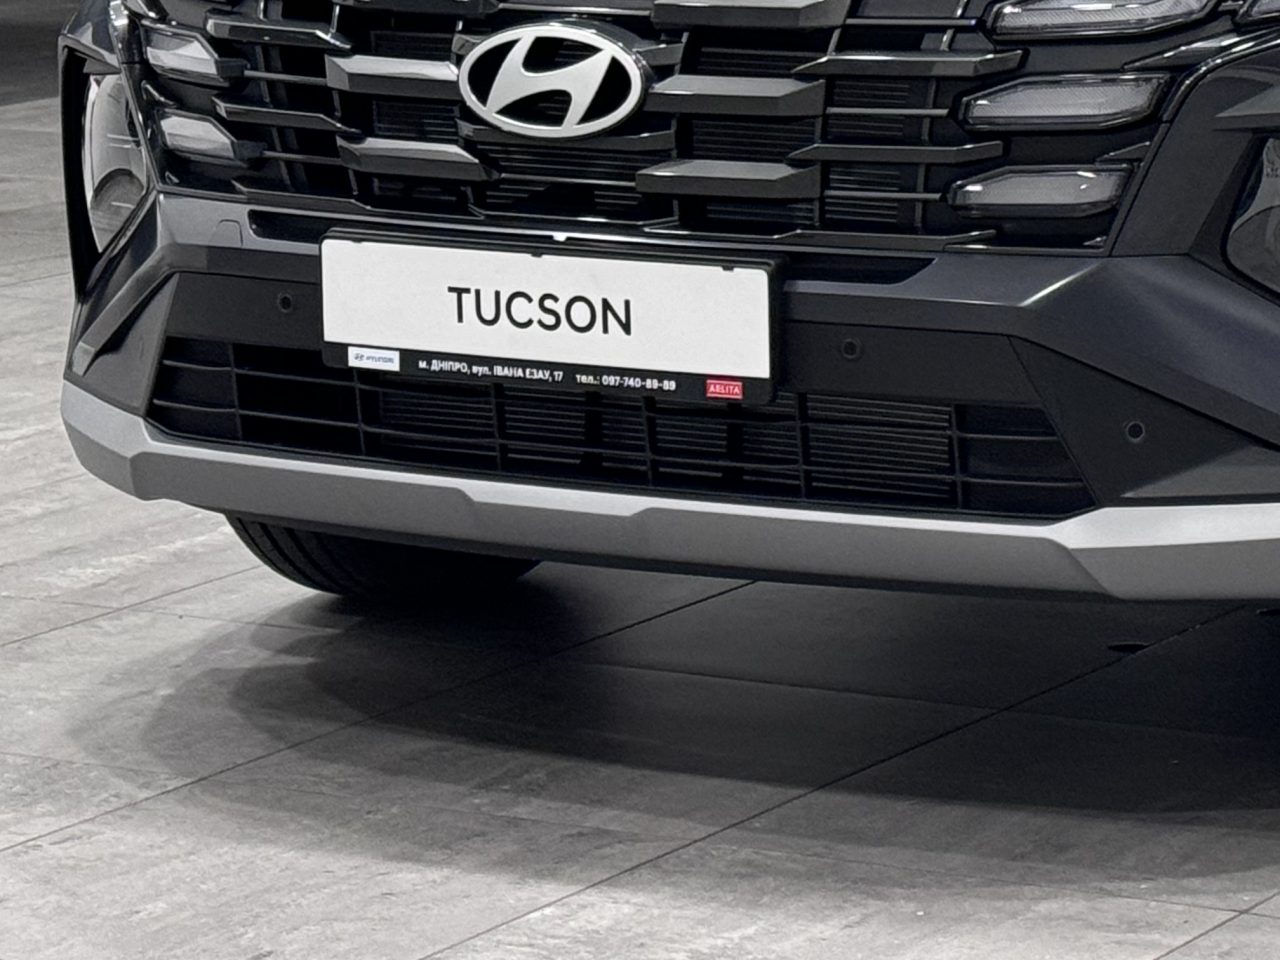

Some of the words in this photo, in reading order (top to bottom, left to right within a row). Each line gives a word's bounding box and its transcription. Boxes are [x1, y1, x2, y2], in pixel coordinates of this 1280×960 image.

[447, 286, 632, 337] TUCSON
[430, 359, 470, 375] ДНІПРО,
[493, 365, 524, 378] ІВАНА
[553, 371, 564, 382] 17
